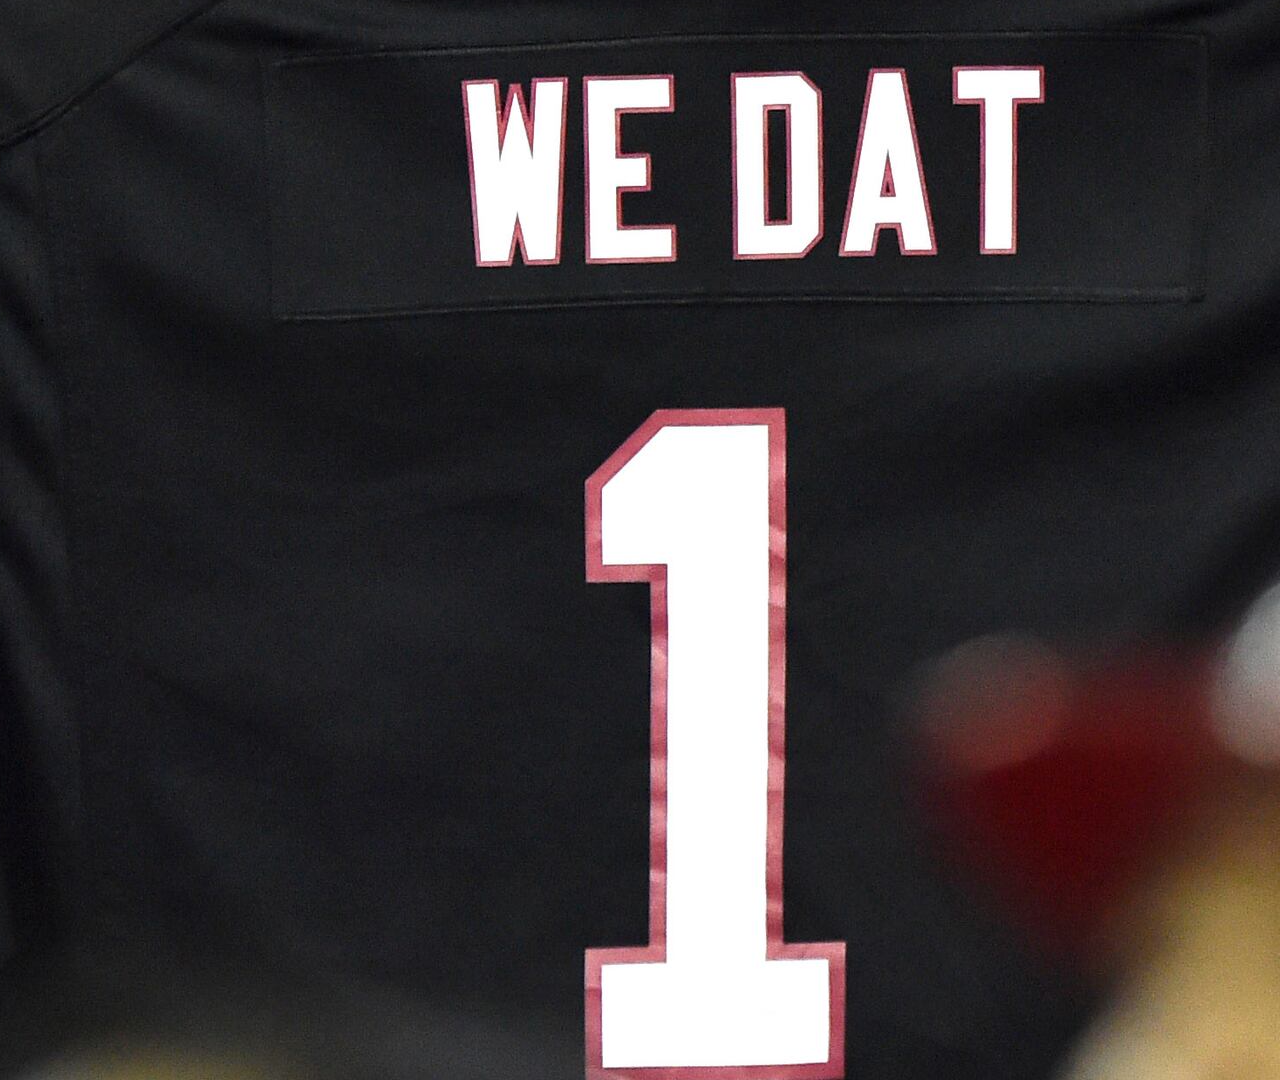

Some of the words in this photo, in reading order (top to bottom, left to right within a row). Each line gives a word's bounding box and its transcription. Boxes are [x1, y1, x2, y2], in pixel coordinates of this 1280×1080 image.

[461, 74, 677, 267] WE
[730, 66, 1045, 260] DAT
[584, 407, 847, 1080] 1
